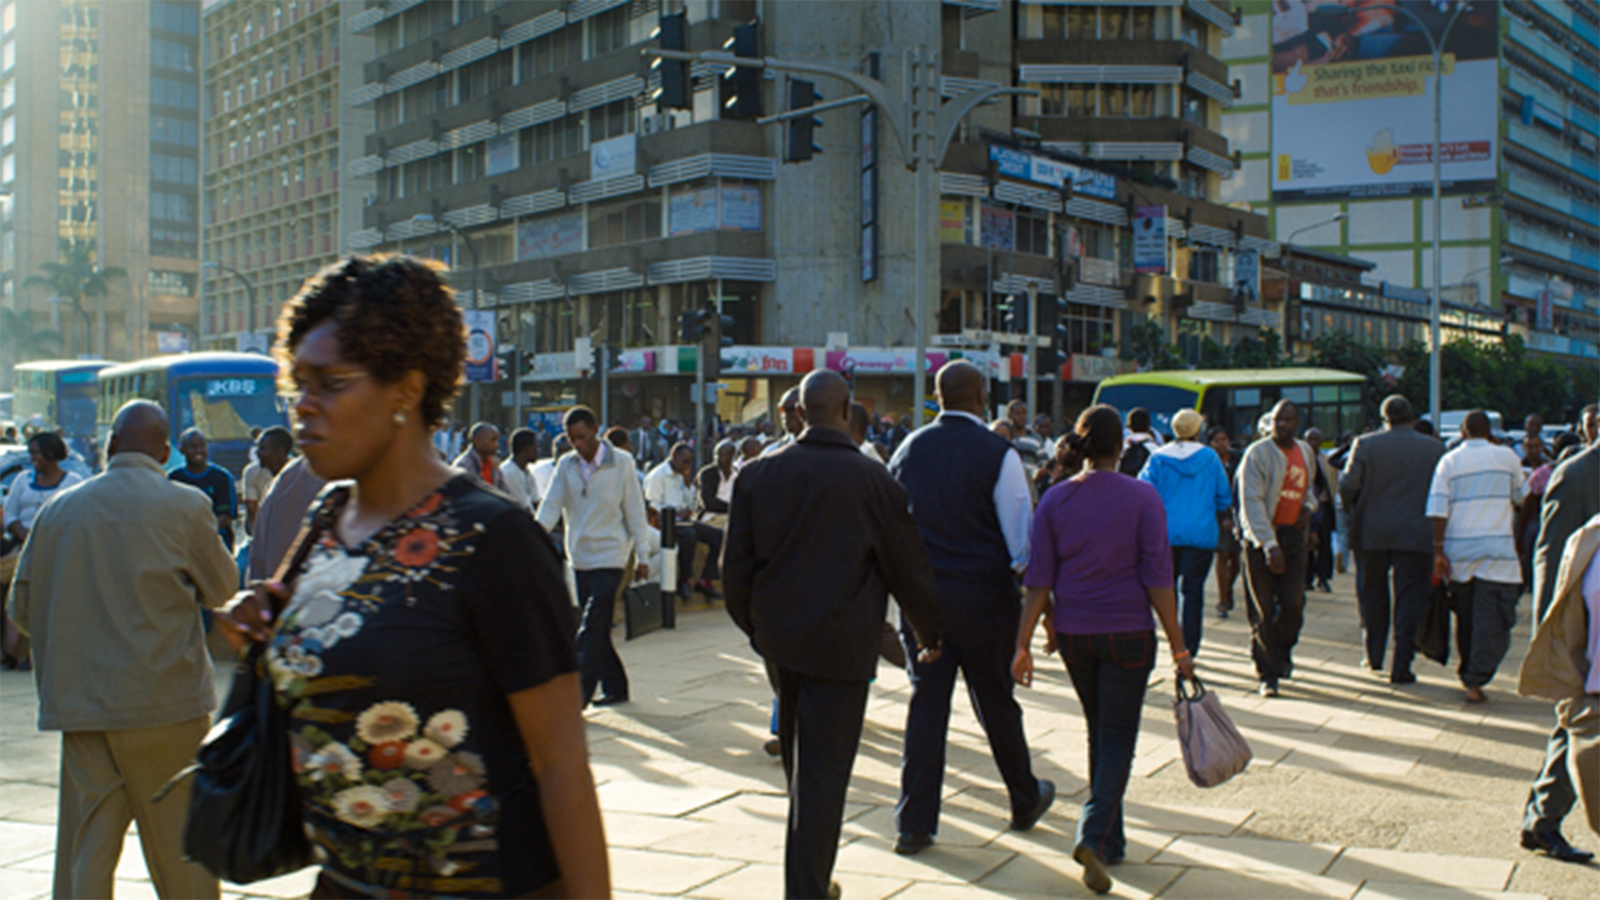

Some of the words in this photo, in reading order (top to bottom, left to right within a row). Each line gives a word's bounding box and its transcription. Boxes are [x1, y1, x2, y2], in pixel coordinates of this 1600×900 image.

[1314, 66, 1362, 82] Sharing
[1366, 63, 1388, 76] the
[1391, 61, 1415, 74] taxi
[1313, 82, 1350, 98] that's
[1353, 78, 1420, 95] friendship.
